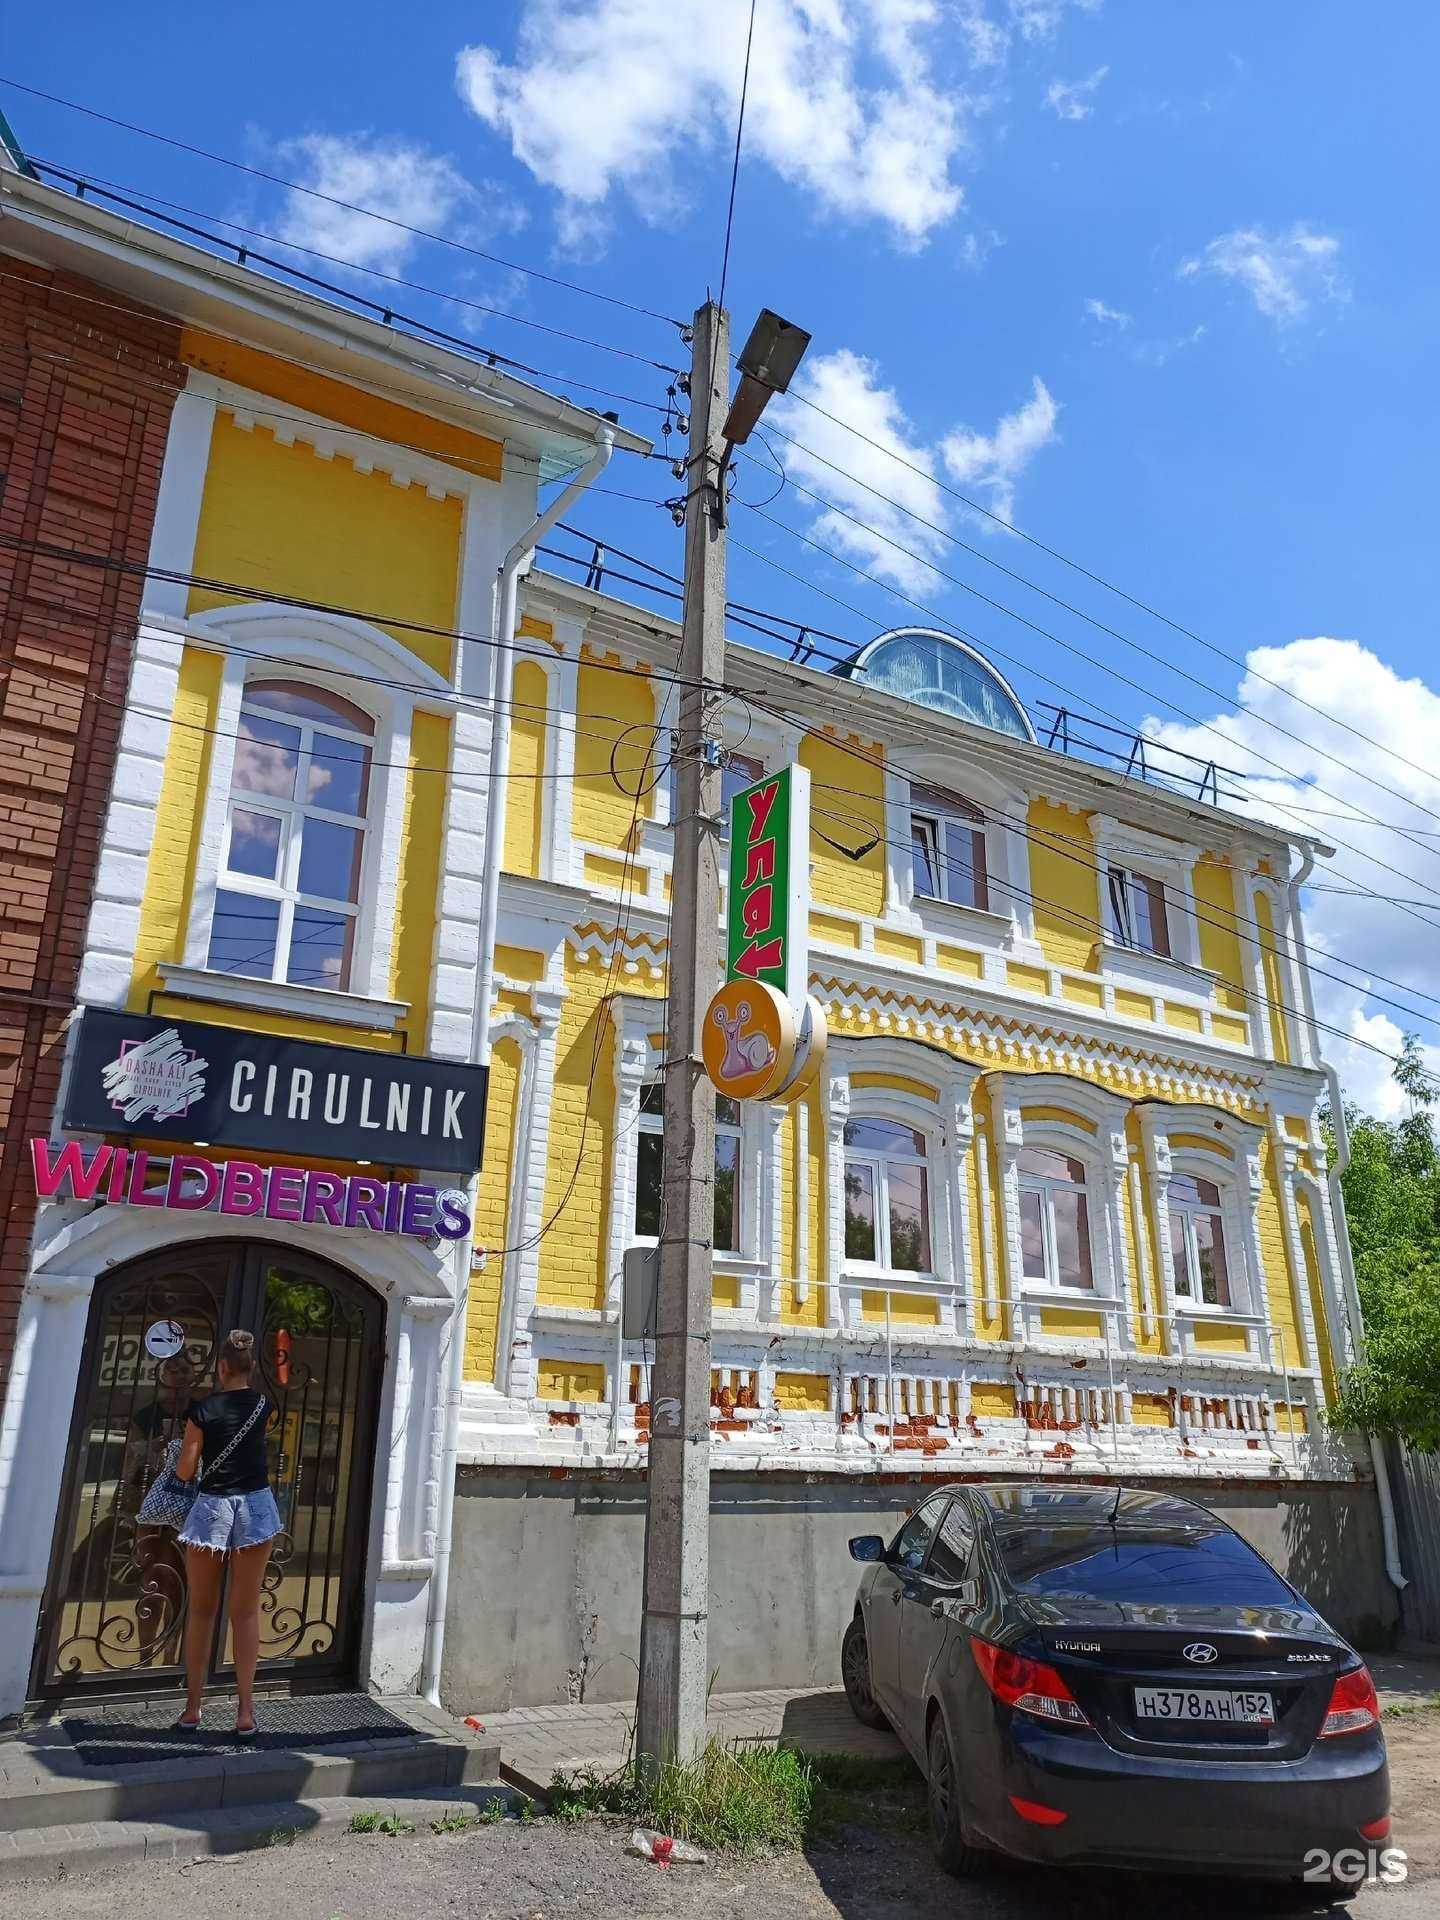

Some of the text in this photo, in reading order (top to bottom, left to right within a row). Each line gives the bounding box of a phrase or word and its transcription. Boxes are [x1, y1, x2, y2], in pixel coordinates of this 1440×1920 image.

[741, 780, 780, 939] УЛЯ
[126, 1058, 163, 1077] DASHA
[167, 1062, 187, 1081] ALI
[229, 1059, 466, 1139] CIRULNIK
[30, 1137, 472, 1240] WILDBERRIES
[1055, 1640, 1101, 1652] HYUNDAI
